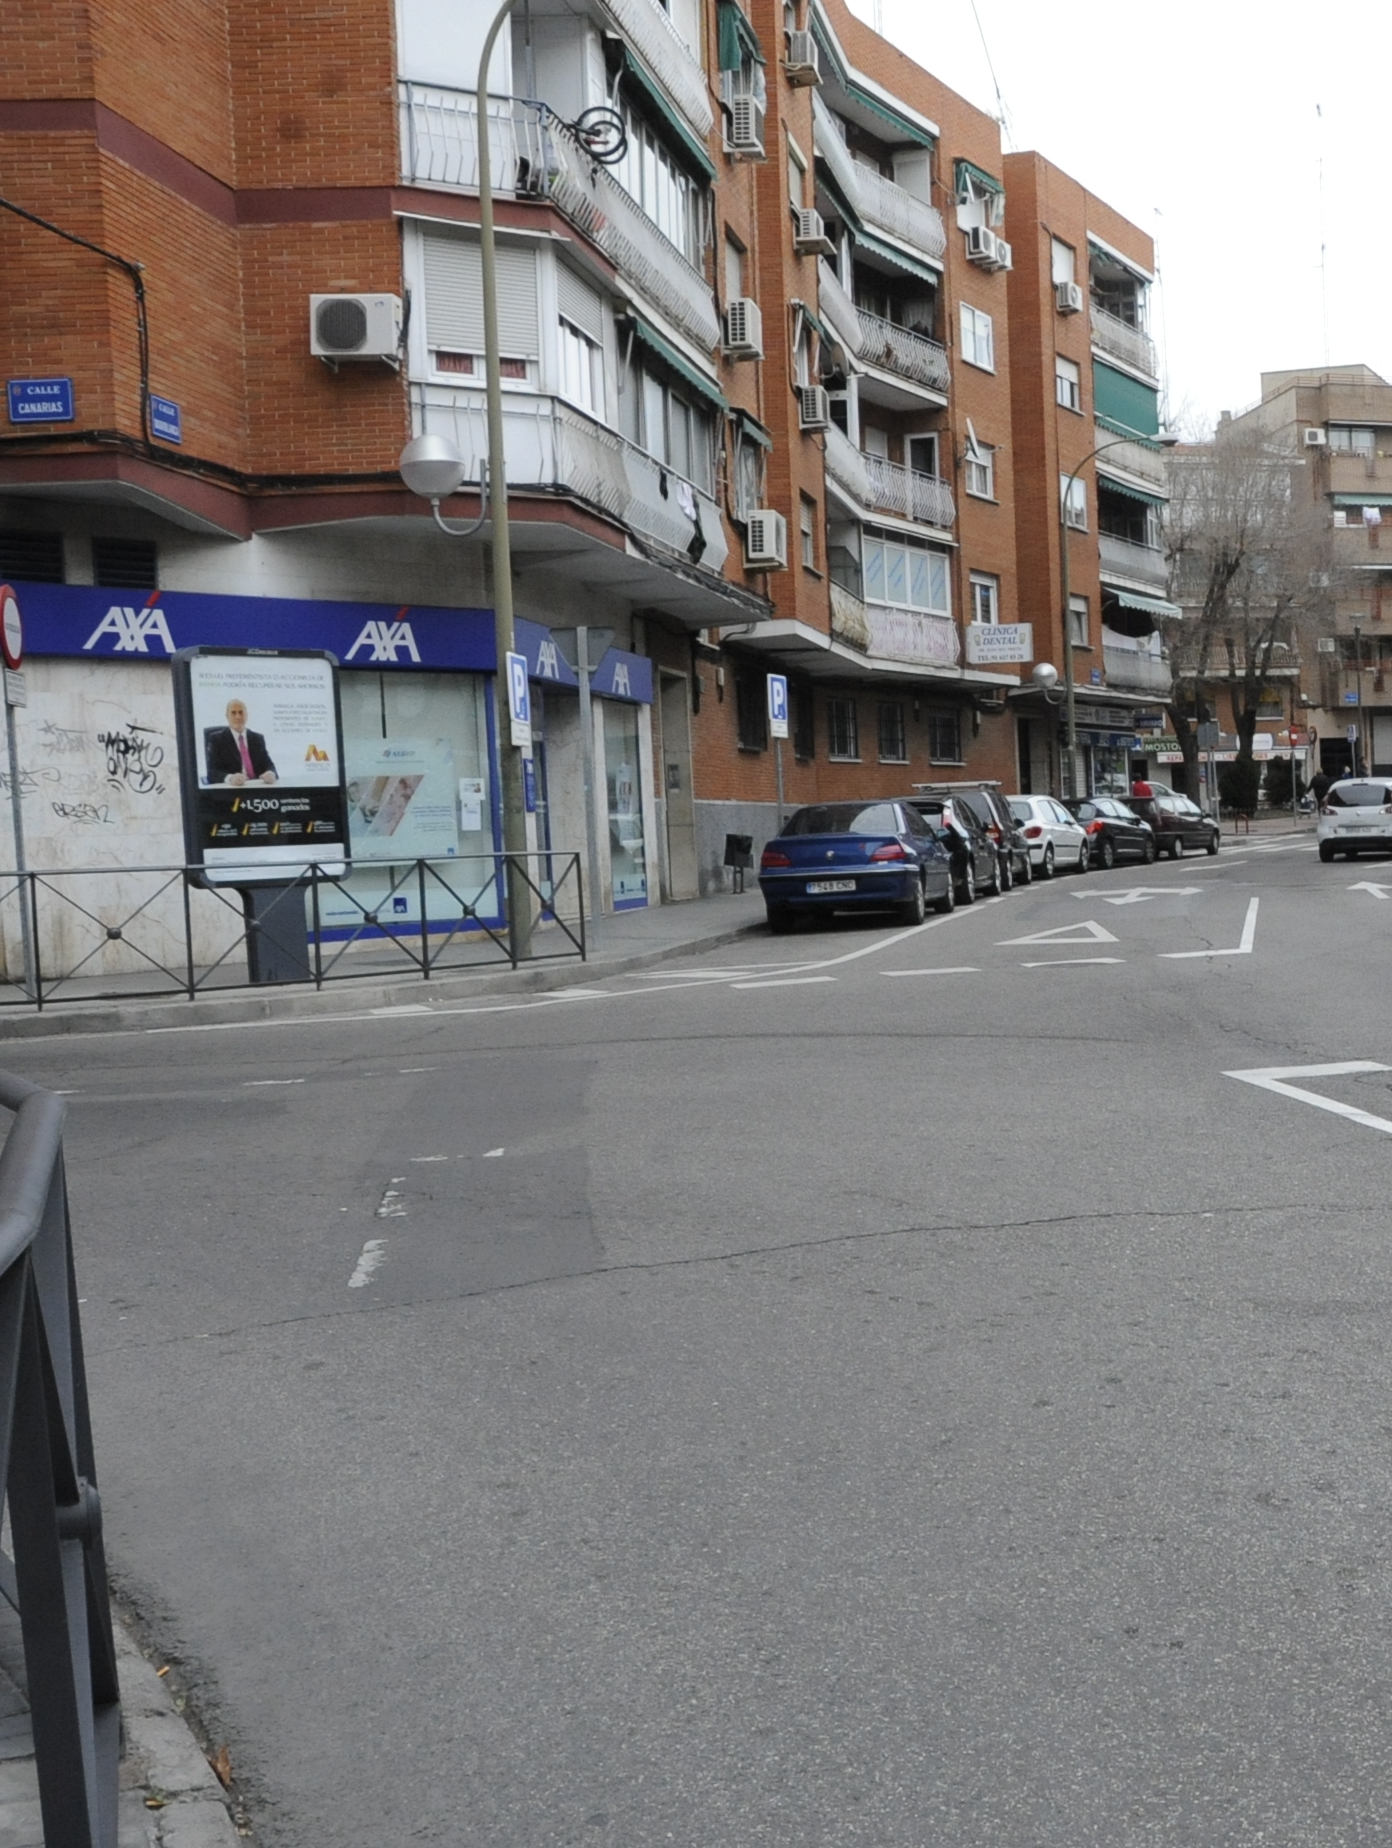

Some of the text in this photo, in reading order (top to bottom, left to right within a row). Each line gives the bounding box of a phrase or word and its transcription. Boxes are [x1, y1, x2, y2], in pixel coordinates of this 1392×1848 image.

[27, 386, 61, 395] CALLE
[18, 402, 64, 414] CANARIAS
[83, 605, 177, 653] AXA
[344, 620, 422, 663] AXA
[982, 636, 1018, 646] DENTAL
[536, 640, 560, 680] AXA
[612, 663, 632, 697] AXA
[772, 681, 784, 716] P
[1145, 742, 1182, 752] MOSTO
